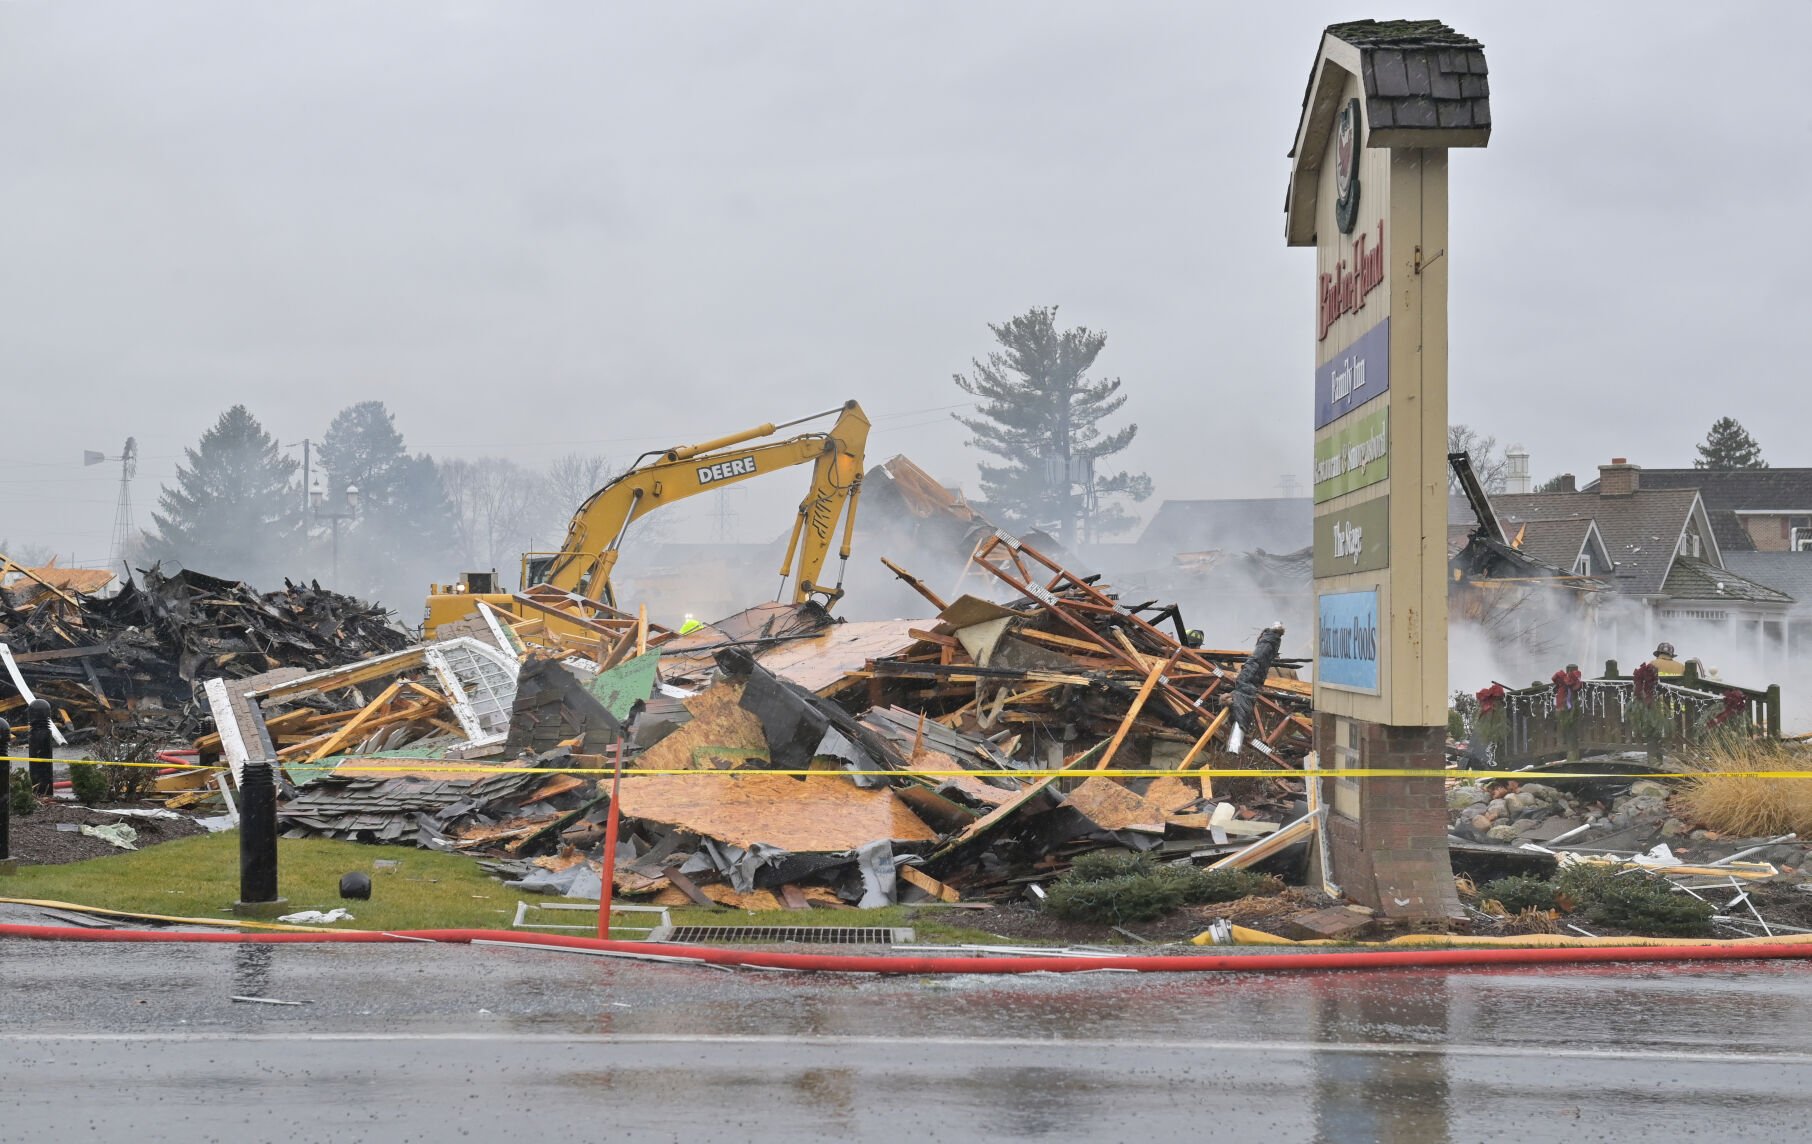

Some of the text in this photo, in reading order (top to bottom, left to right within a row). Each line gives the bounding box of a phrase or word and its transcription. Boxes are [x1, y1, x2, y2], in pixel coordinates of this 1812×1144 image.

[1331, 354, 1366, 405] Family Inn
[698, 457, 756, 484] DEERE
[1333, 520, 1362, 564] The Stage
[1332, 615, 1339, 659] in
[1339, 627, 1352, 660] our
[1353, 612, 1376, 662] Pools
